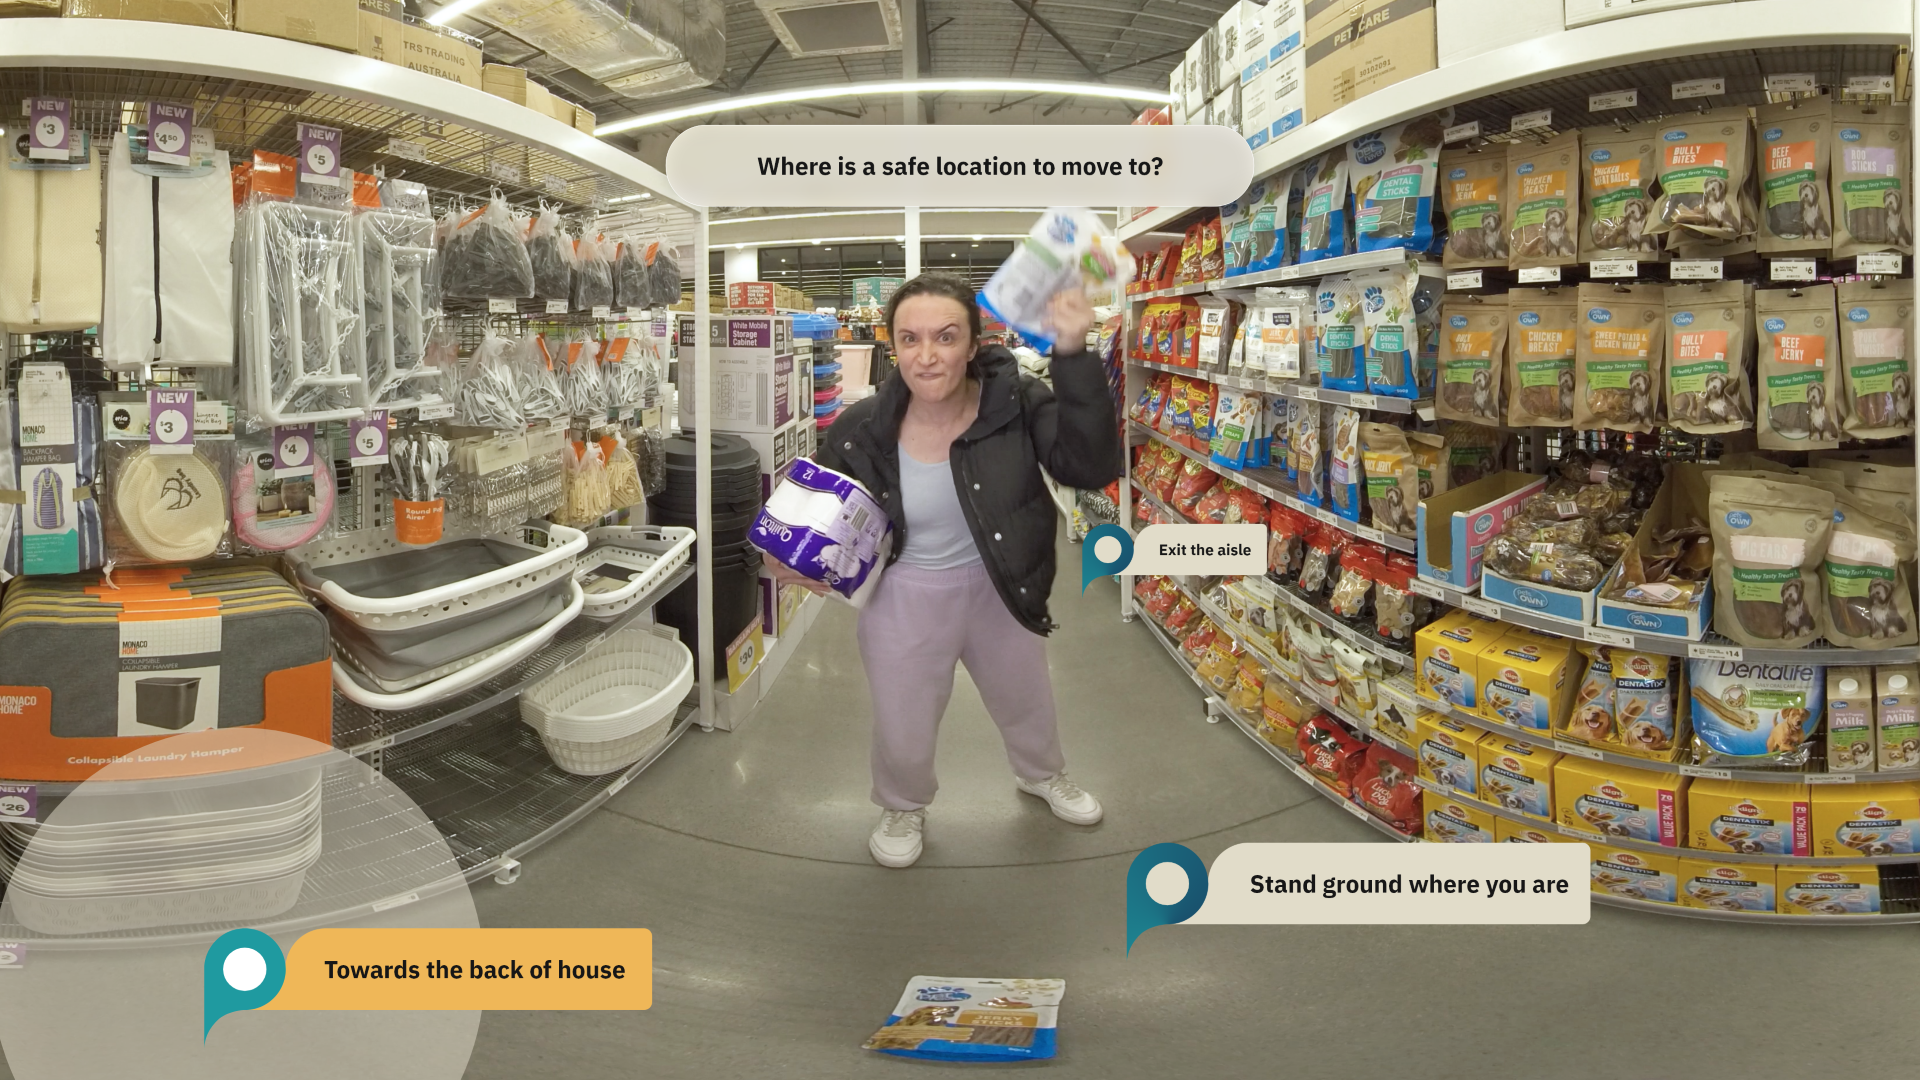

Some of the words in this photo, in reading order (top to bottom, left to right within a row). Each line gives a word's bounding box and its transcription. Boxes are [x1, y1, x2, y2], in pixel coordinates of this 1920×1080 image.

[1334, 26, 1354, 47] PET
[1357, 8, 1391, 32] CARE
[403, 40, 423, 53] TRS
[425, 47, 465, 67] TRADING
[408, 61, 462, 84] AUSTRALIA
[1359, 58, 1392, 78] 30102091
[37, 101, 65, 111] NEW
[156, 104, 187, 119] NEW
[42, 123, 56, 134] $3
[308, 131, 335, 141] NEW
[1357, 142, 1380, 160] pet
[1363, 147, 1387, 164] haven
[1673, 145, 1701, 155] BULLY
[1772, 145, 1790, 159] BEEF
[1851, 149, 1867, 161] ROO
[313, 153, 327, 165] $5
[1672, 155, 1697, 165] BITES
[1772, 157, 1792, 170] LIVER
[1594, 165, 1620, 176] CHICKEN
[1851, 160, 1877, 172] STICKS
[1383, 176, 1414, 188] DENTAL
[1523, 174, 1553, 187] CHICKEN
[1610, 172, 1630, 183] BALLS
[1382, 186, 1411, 197] STICKS
[1456, 191, 1477, 201] JERKY
[1626, 263, 1634, 271] $6
[1710, 265, 1719, 274] $8
[1891, 260, 1899, 268] $6
[1805, 266, 1813, 274] $6
[712, 325, 718, 337] 5
[733, 330, 758, 340] Storage
[1595, 330, 1616, 340] SWEET
[1618, 332, 1640, 341] POTATO
[1641, 332, 1647, 341] &
[733, 338, 758, 346] Cabinet
[1528, 332, 1562, 342] CHICKEN
[1681, 334, 1705, 345] BULLY
[1781, 336, 1800, 349] BEEF
[1528, 342, 1559, 352] BREAST
[1595, 339, 1620, 349] CHICKEN
[1622, 341, 1641, 350] WRAP
[1680, 345, 1700, 357] BITES
[1781, 348, 1804, 361] JERKY
[156, 392, 188, 404] NEW
[160, 421, 174, 434] $3
[210, 418, 222, 426] Bag
[281, 422, 308, 431] NEW
[22, 425, 46, 435] MONACO
[23, 434, 38, 443] HOME
[362, 438, 374, 449] $5
[23, 448, 53, 456] BACKPACK
[284, 444, 297, 455] $4
[405, 507, 431, 515] Round
[1730, 517, 1750, 525] OWN
[759, 515, 793, 542] Quilton
[1740, 541, 1758, 558] PIG
[1760, 541, 1788, 559] EARS
[1850, 539, 1880, 556] EARS
[1741, 572, 1762, 580] Healthy
[1762, 572, 1777, 580] Tasty
[1831, 567, 1850, 576] Healthy
[1850, 568, 1866, 576] Tasty
[1519, 594, 1544, 606] OWN
[1633, 618, 1659, 628] OWN
[122, 640, 148, 649] MONACO
[739, 645, 753, 665] $30
[1430, 658, 1459, 671] DENTASTIX
[1624, 662, 1659, 671] Pedigree
[1717, 660, 1814, 681] Dentalife
[1495, 681, 1528, 694] DENTASTIX
[1618, 679, 1664, 688] DENTASTIX
[1835, 716, 1864, 726] Milk
[1886, 713, 1915, 723] Milk
[1314, 747, 1336, 762] Lucky
[1428, 741, 1464, 757] DENTASTIX
[67, 755, 134, 766] Collapsible
[137, 753, 188, 763] Laundry
[190, 746, 245, 759] Hamper
[1317, 756, 1332, 769] Dog
[1491, 765, 1532, 782] DENTASTIX
[1371, 782, 1393, 799] Lucky
[1371, 791, 1389, 806] Dog
[1586, 795, 1635, 810] DENTASTIX
[1660, 794, 1673, 802] 70
[1, 803, 26, 812] $26
[1662, 804, 1674, 821] PACK
[1436, 811, 1477, 829] DENTASTIX
[1722, 816, 1771, 825] DENTASTIX
[1798, 816, 1808, 832] PACK
[1848, 820, 1897, 828] DENTASTIX
[1662, 821, 1674, 838] VALUE
[1798, 832, 1808, 849] VALUE
[1600, 862, 1655, 875] DENTASTIX
[1699, 878, 1753, 887] DENTASTIX
